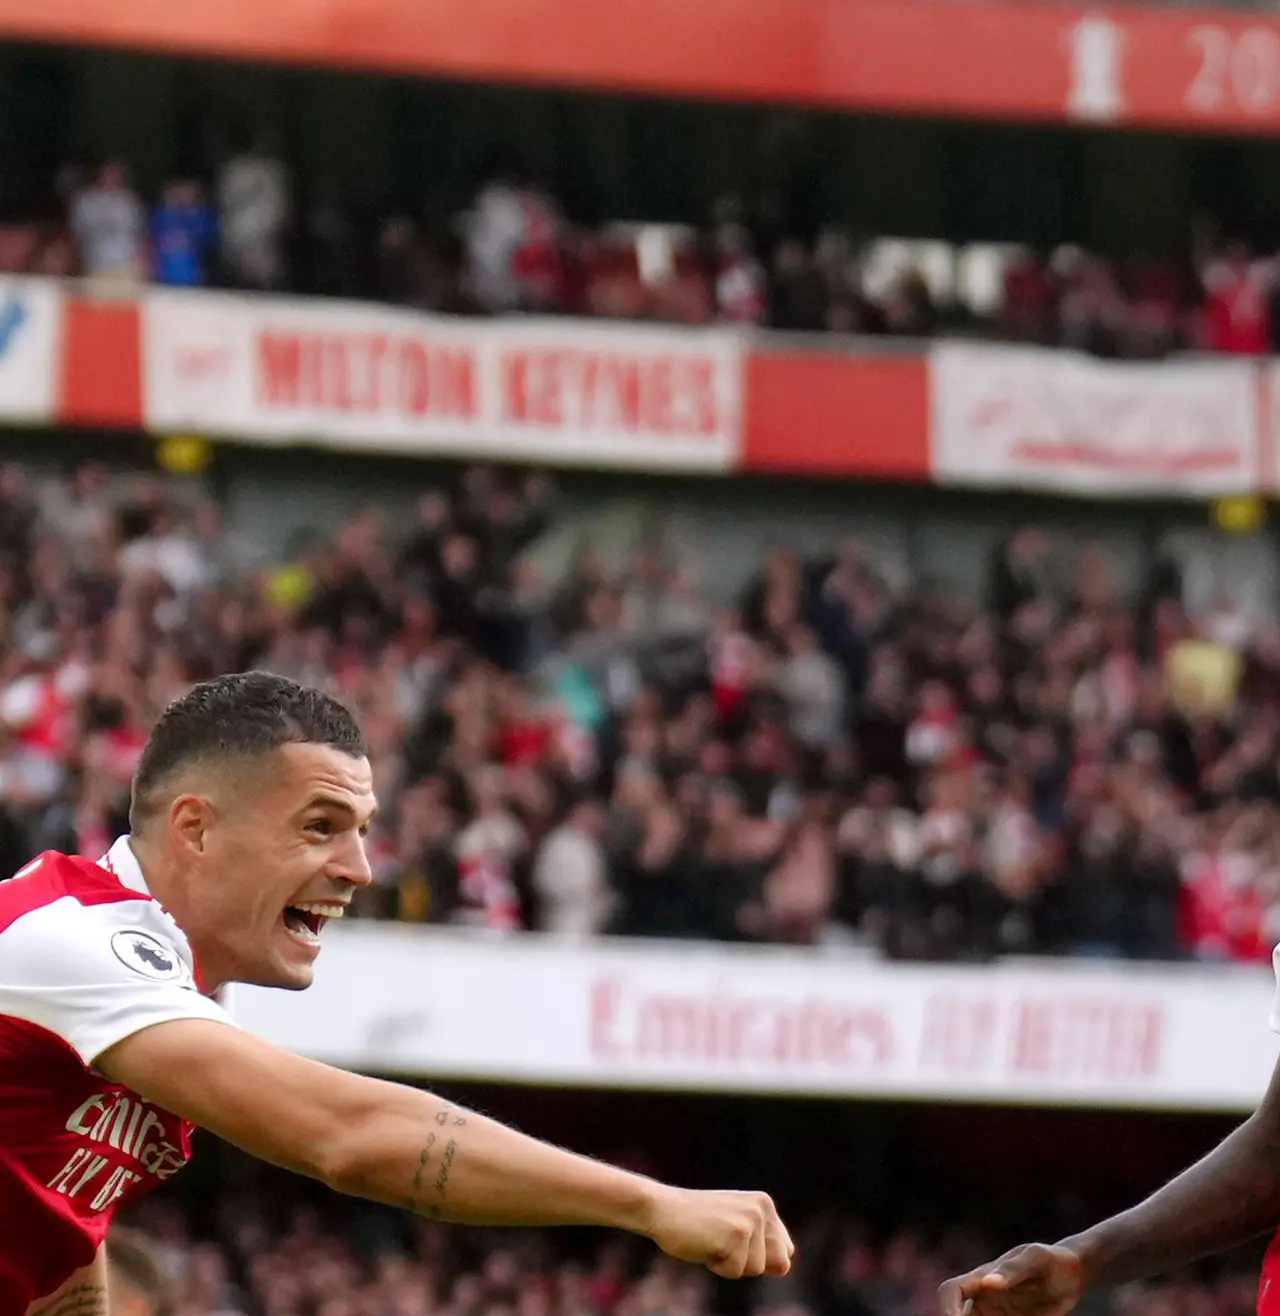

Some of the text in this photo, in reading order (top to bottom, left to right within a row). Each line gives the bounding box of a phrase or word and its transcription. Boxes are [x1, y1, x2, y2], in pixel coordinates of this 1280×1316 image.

[256, 330, 720, 436] MILTON KEYNES
[46, 1147, 109, 1198] FLY
